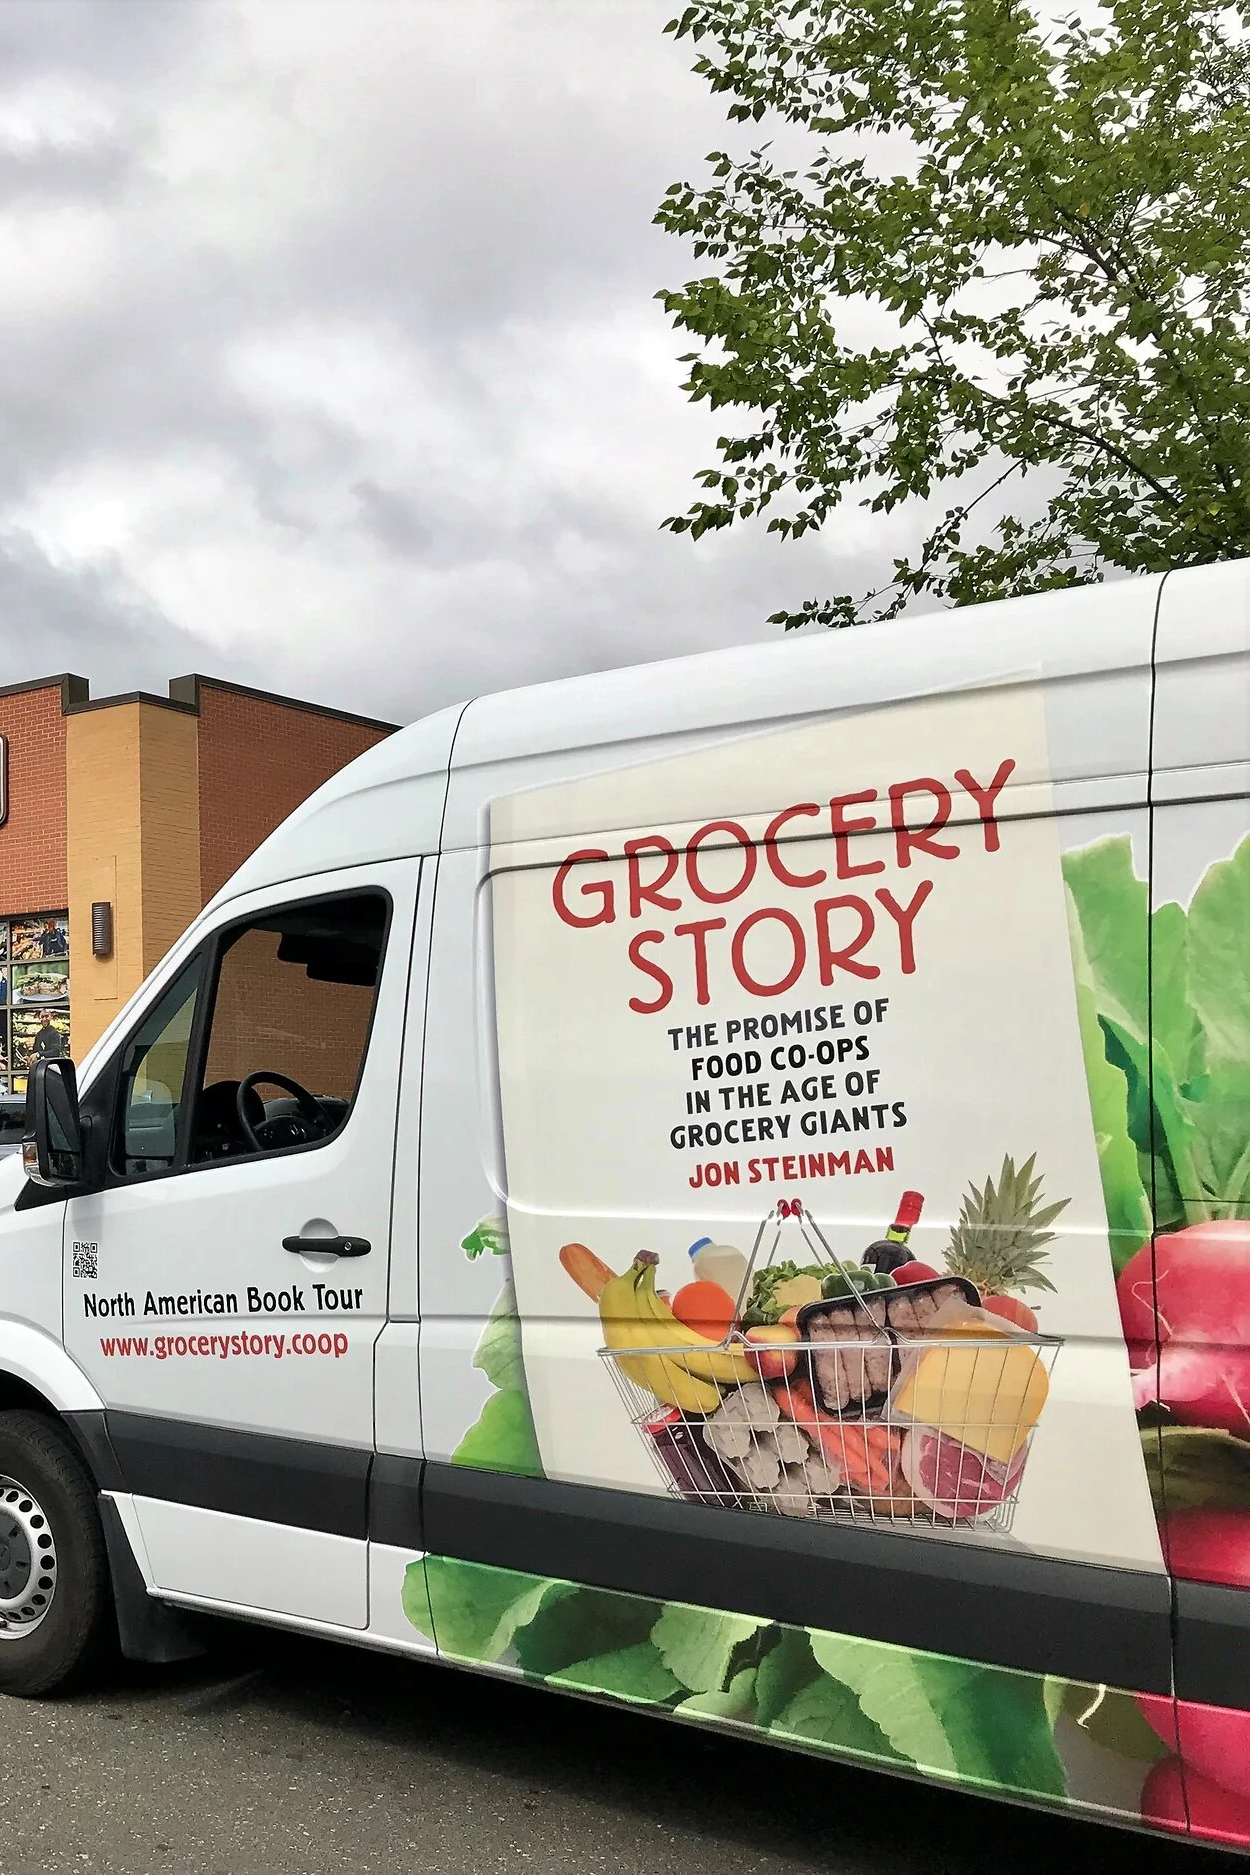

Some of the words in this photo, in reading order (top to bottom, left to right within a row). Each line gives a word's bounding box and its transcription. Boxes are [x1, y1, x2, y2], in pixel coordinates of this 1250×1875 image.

[552, 759, 1016, 928] GROCERY
[628, 880, 934, 1014] STORY
[668, 1023, 718, 1050] THE
[726, 1004, 846, 1043] PROMISE
[853, 998, 889, 1026] OF
[691, 1050, 762, 1081] FOOD
[770, 1035, 870, 1070] CO-OPS
[686, 1090, 711, 1115] IN
[718, 1083, 772, 1110] THE
[780, 1075, 837, 1105] AGE
[845, 1069, 881, 1096] OF
[670, 1115, 791, 1149] GROCERY
[800, 1101, 907, 1136] GIANTS
[689, 1161, 740, 1188] JON
[747, 1146, 894, 1183] STEINMAN
[83, 1292, 136, 1317] North
[143, 1290, 238, 1316] American
[247, 1285, 305, 1312] Book
[312, 1283, 363, 1310] Tour
[100, 1330, 348, 1359] www.grocerystory.coop
